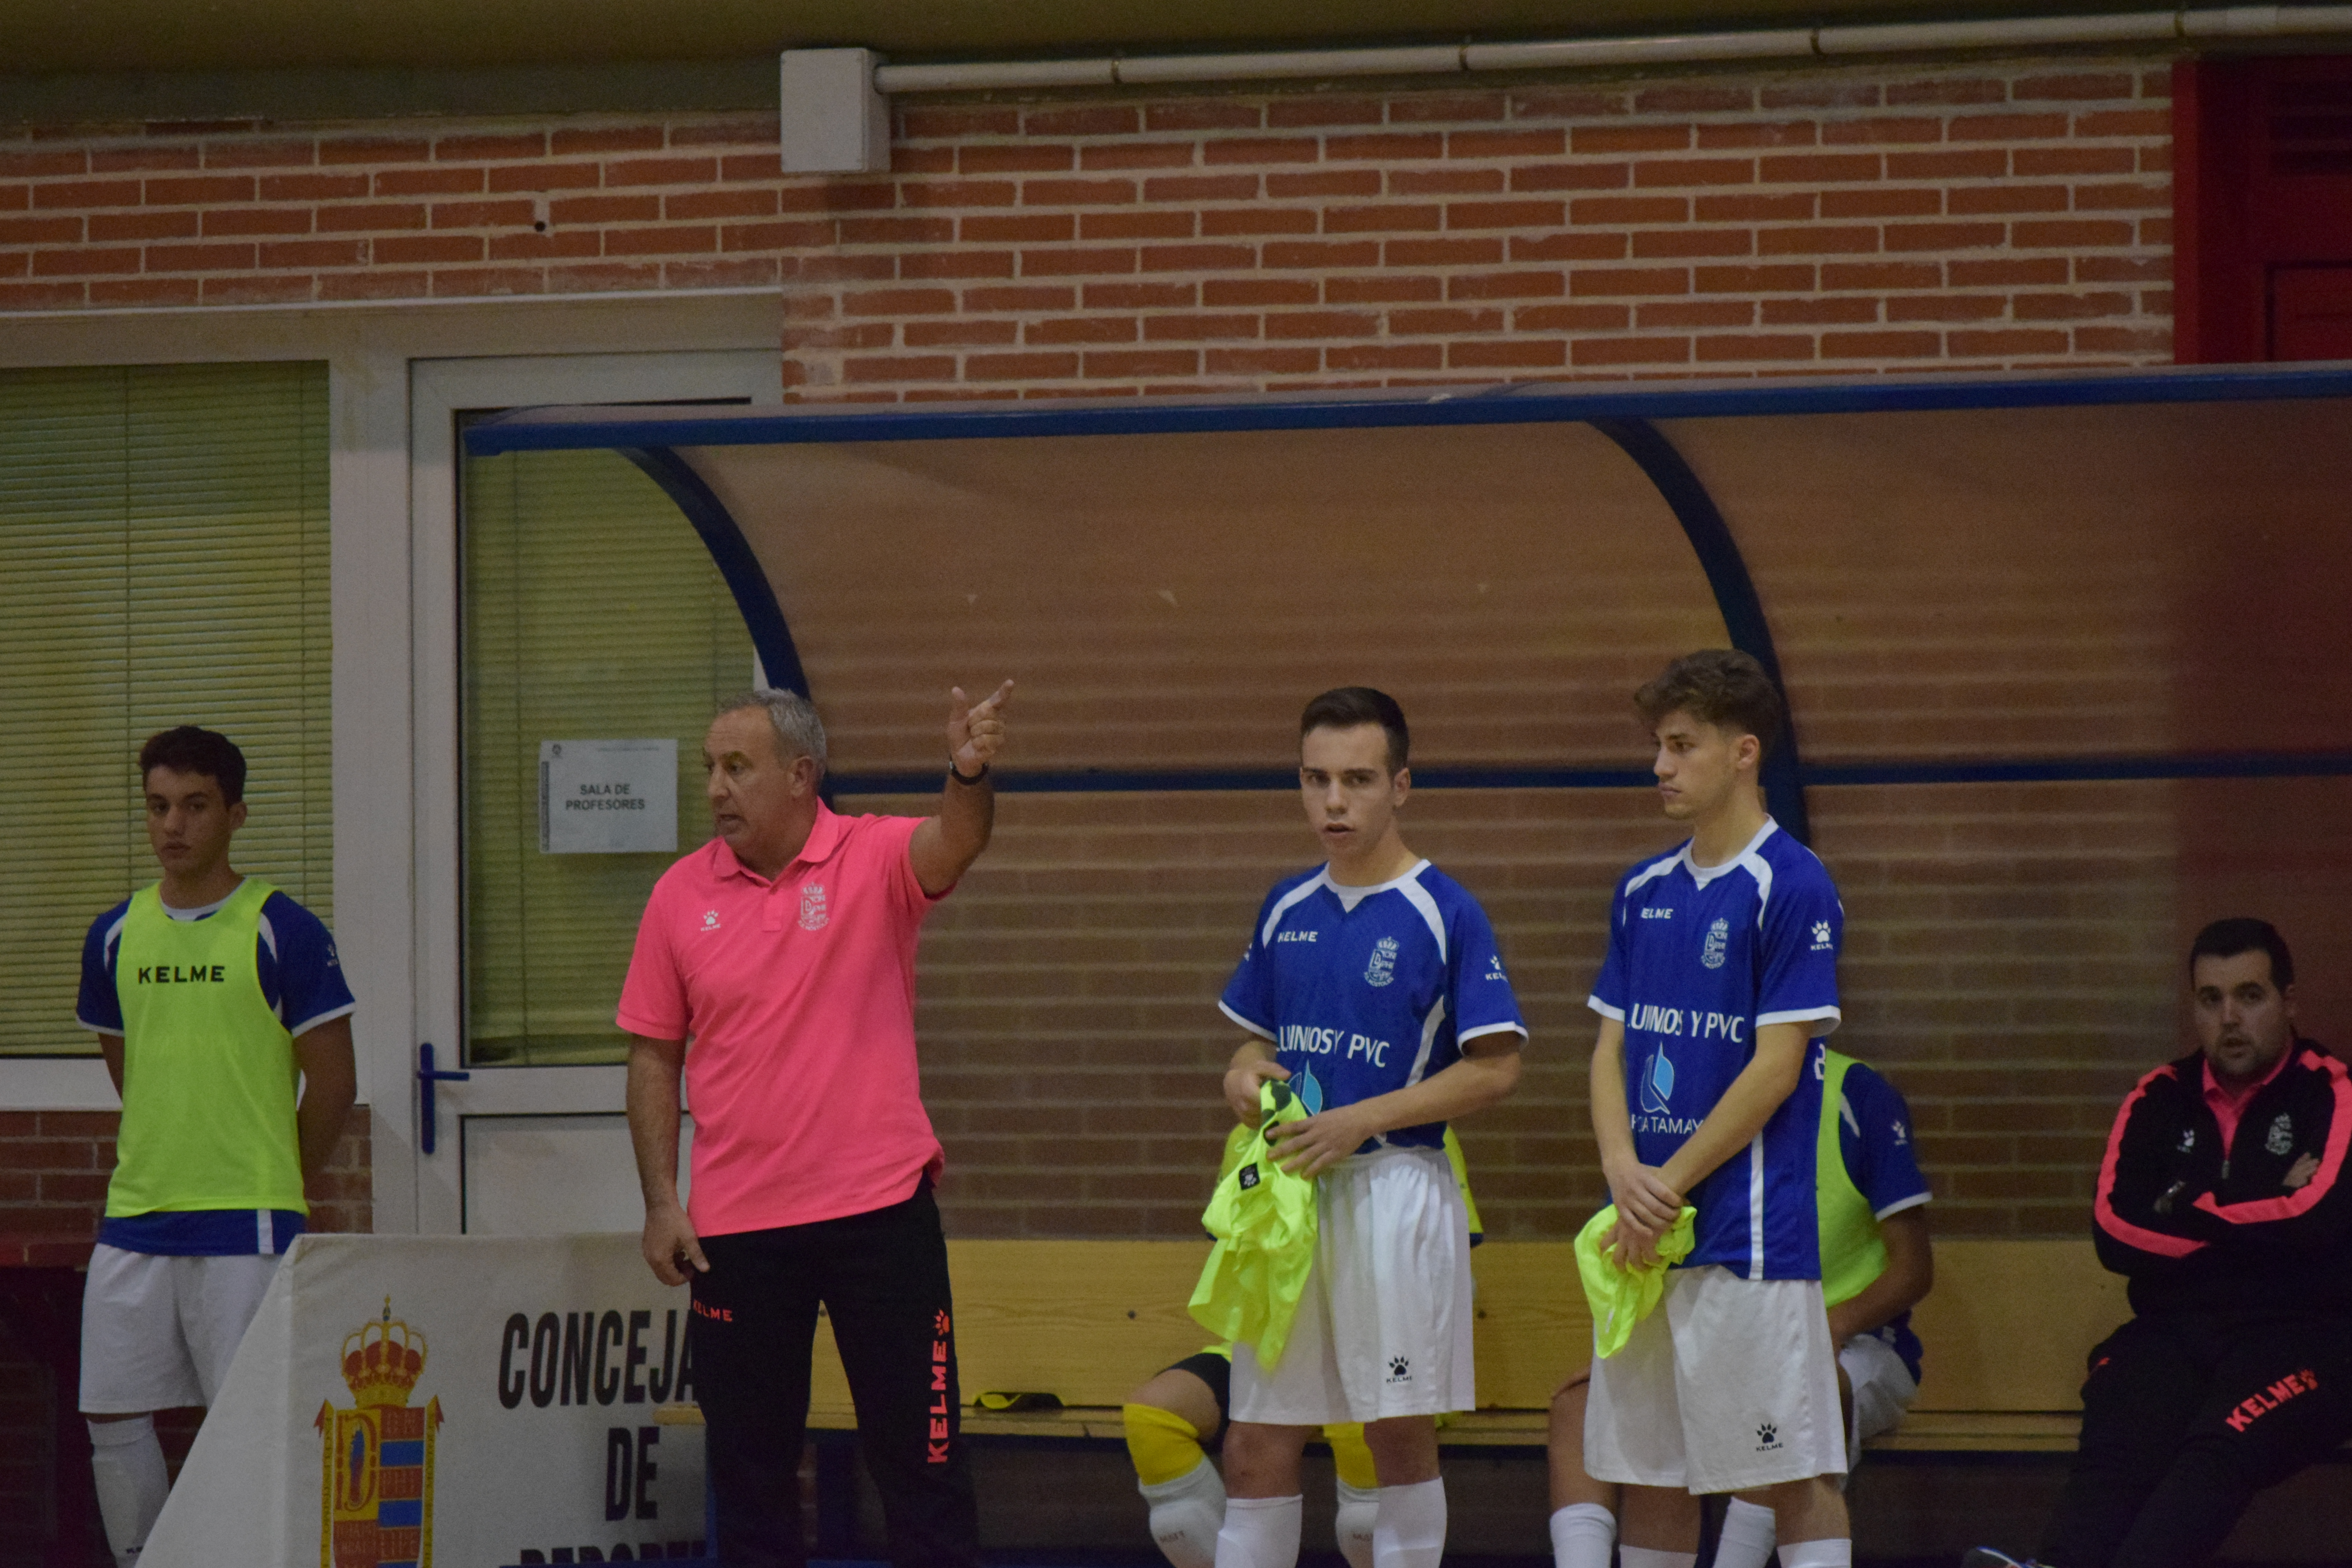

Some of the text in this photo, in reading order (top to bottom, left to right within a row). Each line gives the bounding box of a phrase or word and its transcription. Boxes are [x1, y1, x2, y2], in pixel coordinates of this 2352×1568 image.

[565, 798, 645, 810] PROFESORES
[580, 784, 630, 795] SALA DE
[138, 965, 225, 984] KELME
[1691, 1010, 1703, 1037] Y
[1704, 1012, 1744, 1043] PVC
[1347, 1033, 1390, 1068] PVC
[498, 1309, 697, 1409] CONCEJA
[927, 1340, 949, 1463] KELME
[2225, 1374, 2305, 1432] KELME
[1756, 1442, 1784, 1452] KELME
[606, 1425, 660, 1521] DE
